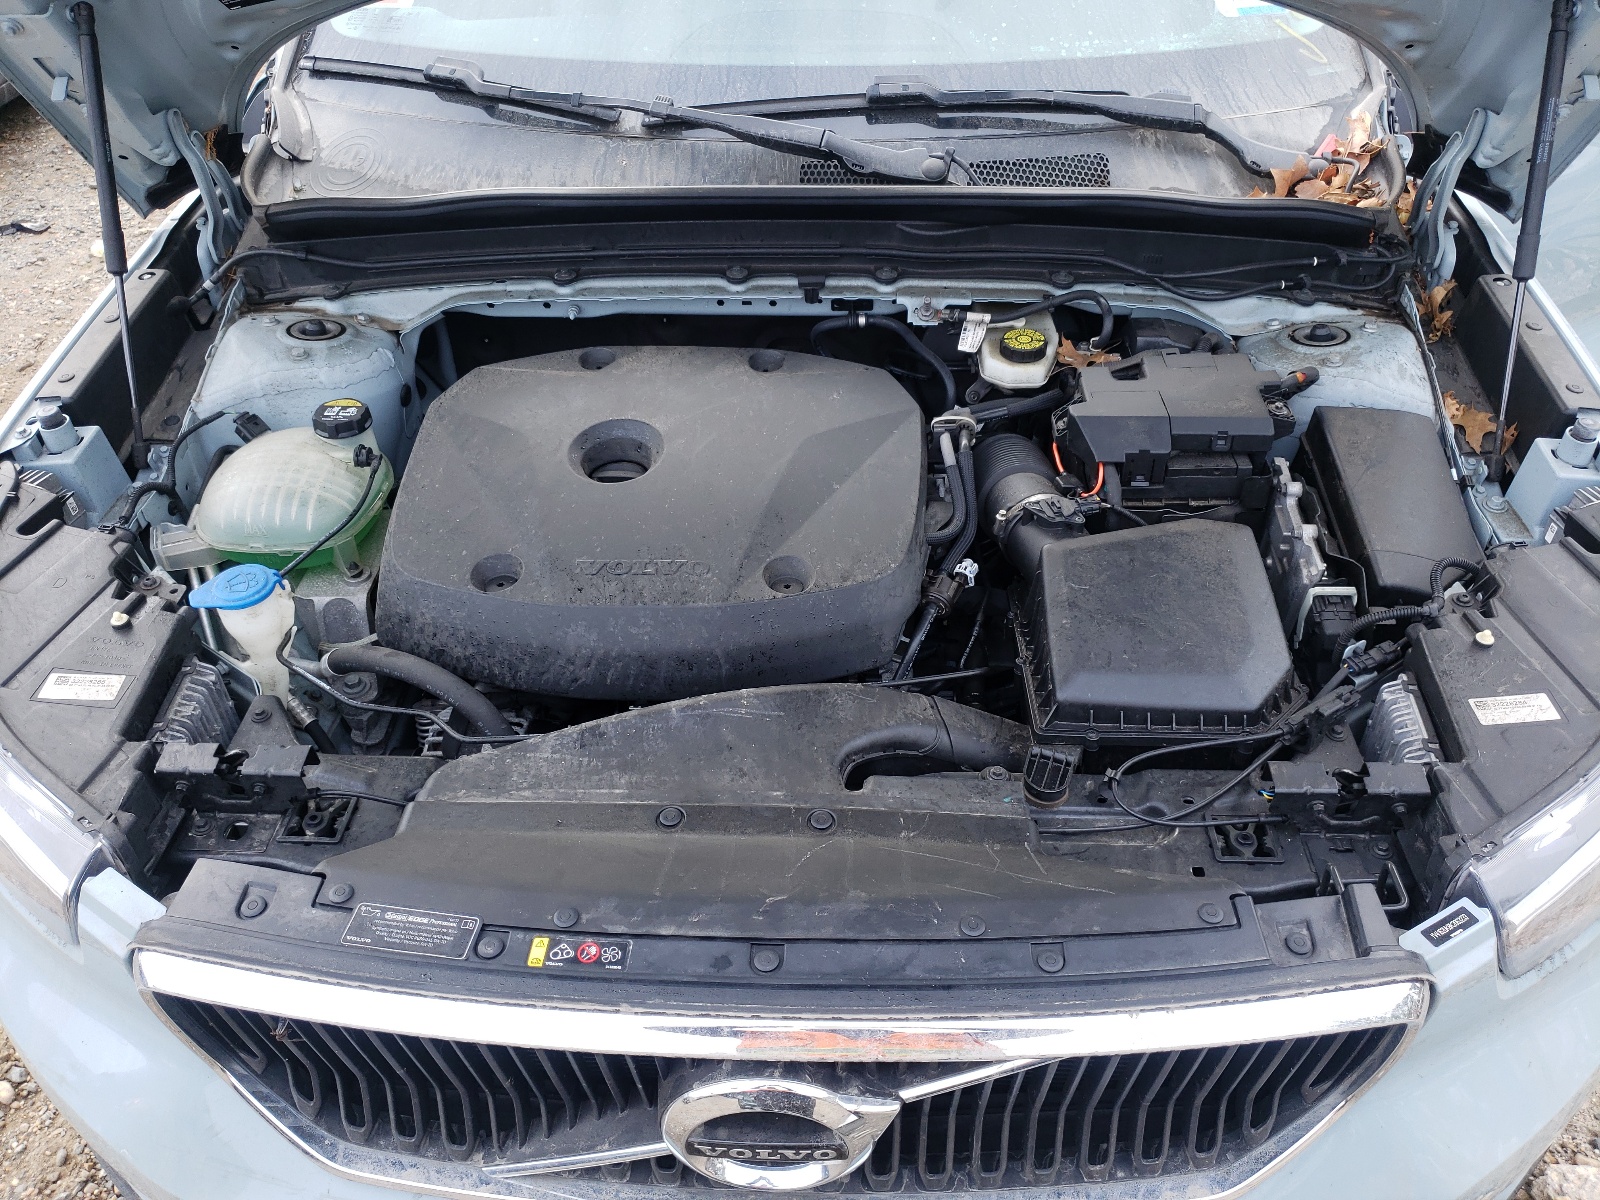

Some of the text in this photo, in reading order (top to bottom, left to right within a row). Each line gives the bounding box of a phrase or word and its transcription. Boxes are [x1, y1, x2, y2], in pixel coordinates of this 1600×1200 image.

[243, 523, 268, 535] MAX
[576, 559, 711, 576] VOLVO
[408, 915, 430, 924] EDGE
[346, 935, 372, 943] VOLVO
[694, 1143, 837, 1160] VOLVO
